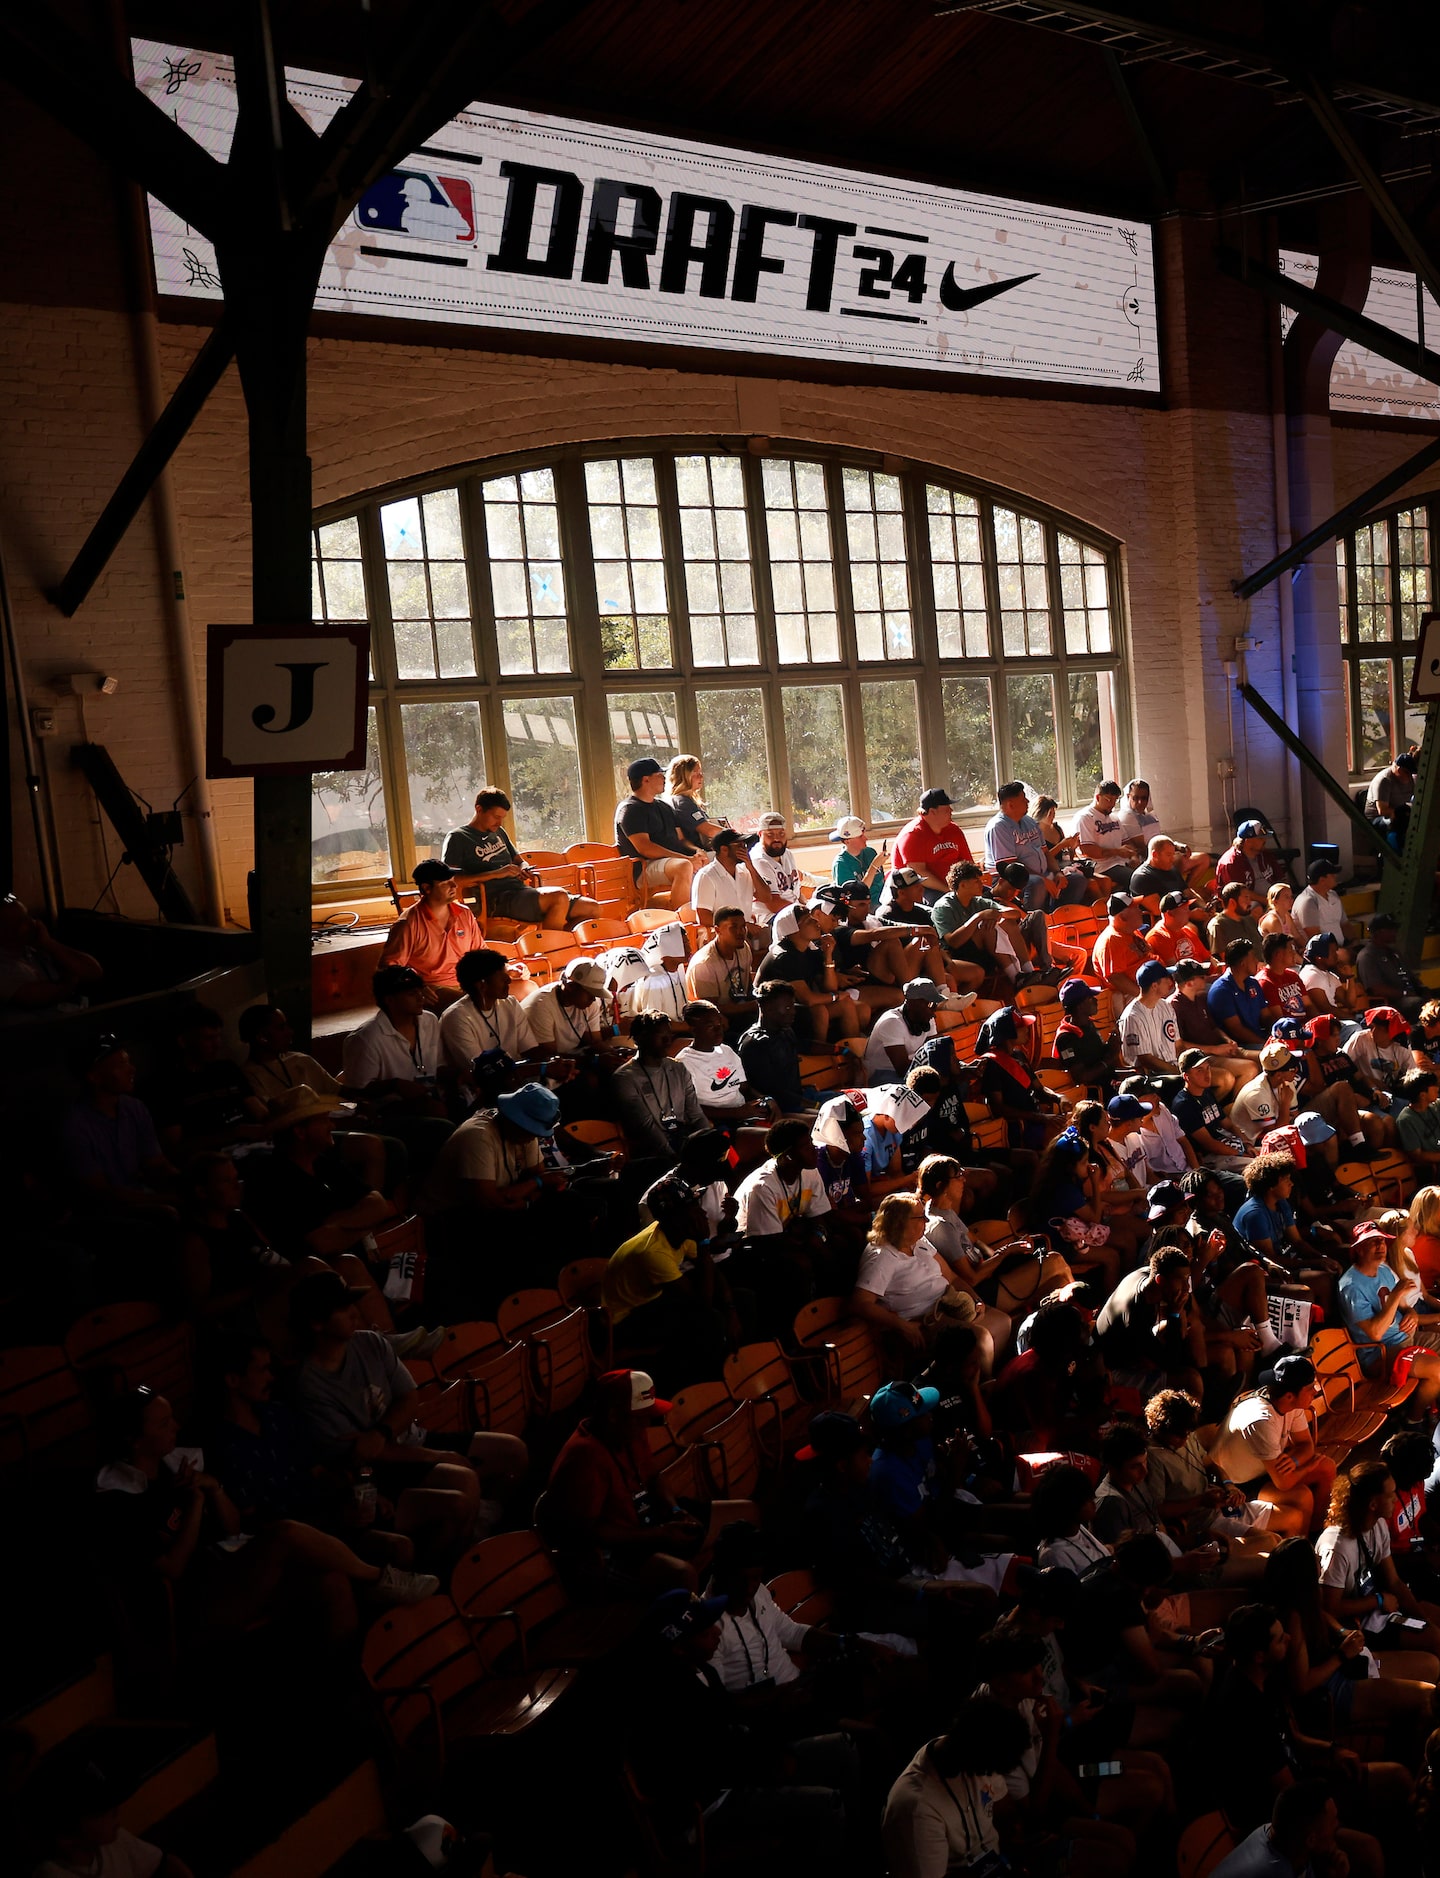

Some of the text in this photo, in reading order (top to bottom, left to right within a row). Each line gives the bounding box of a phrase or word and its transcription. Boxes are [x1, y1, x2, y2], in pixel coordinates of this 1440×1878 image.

[486, 160, 858, 313] DRAFT
[853, 245, 928, 304] 24
[251, 662, 330, 734] J
[682, 1609, 694, 1623] T
